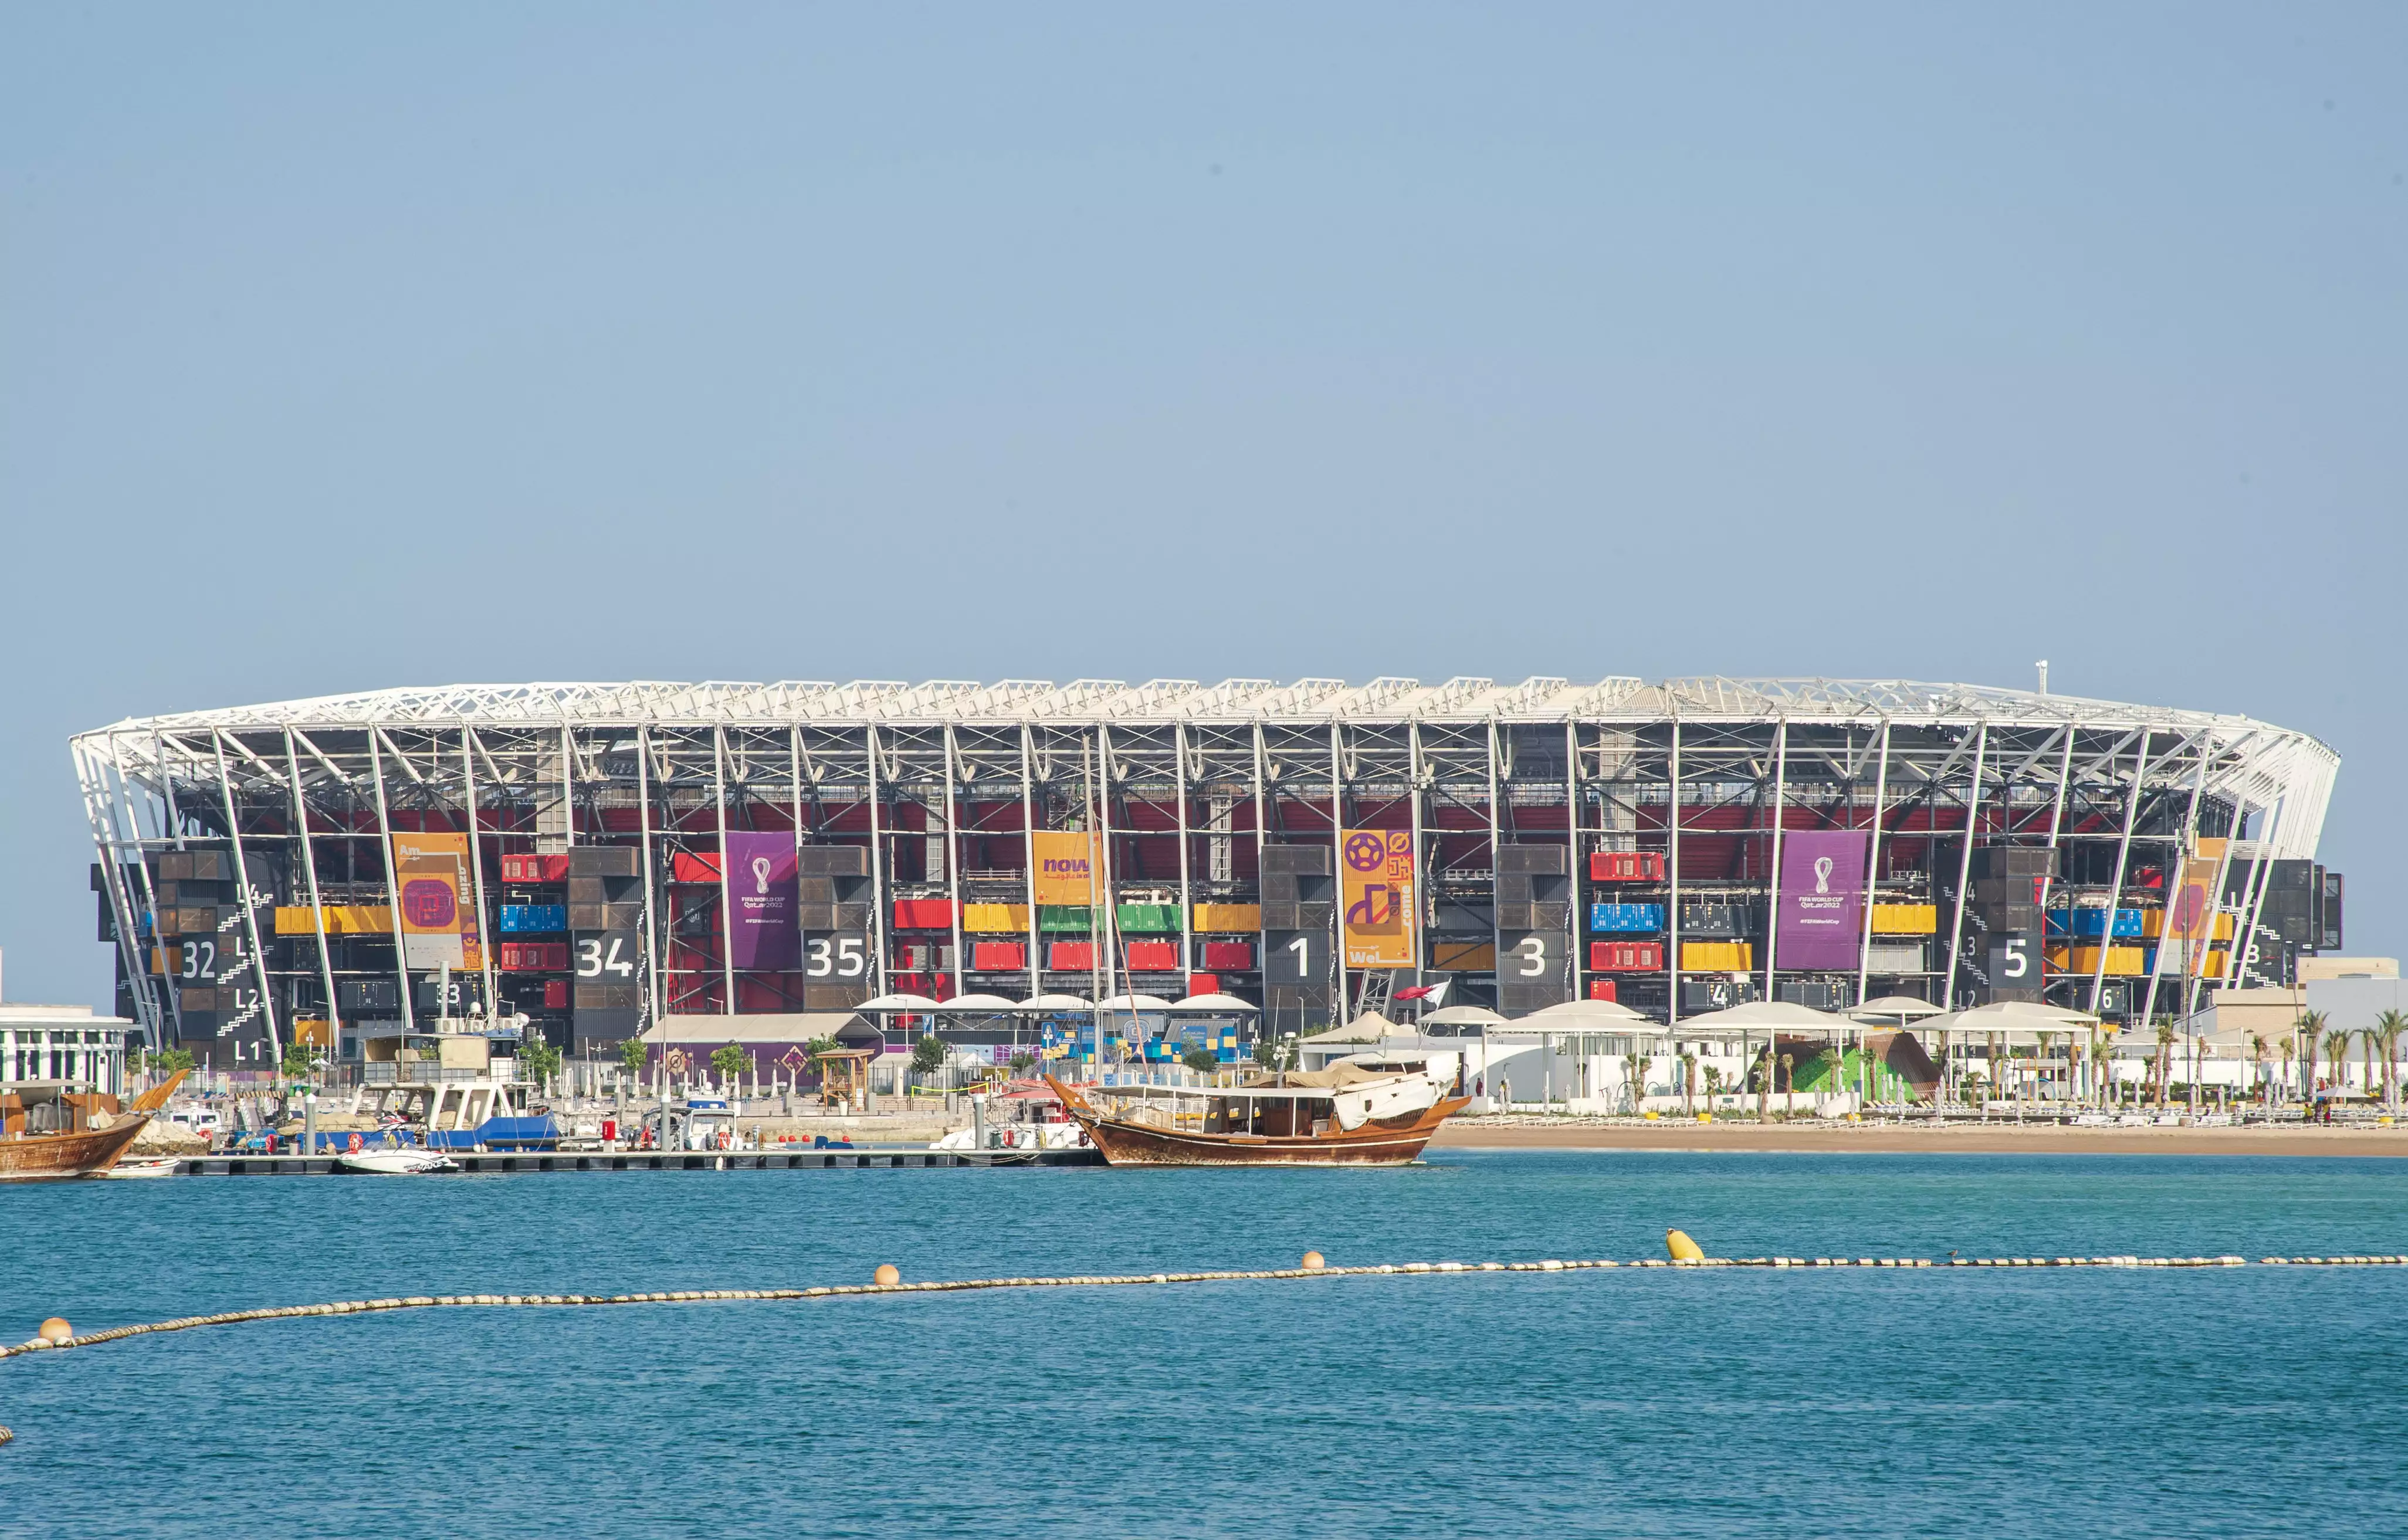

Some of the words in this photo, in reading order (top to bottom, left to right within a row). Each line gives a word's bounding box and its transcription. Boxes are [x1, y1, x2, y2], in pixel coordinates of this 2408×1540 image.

[1043, 859, 1089, 873] now
[183, 941, 215, 978] 32
[577, 938, 633, 976] 34
[807, 938, 863, 976] 35
[1289, 938, 1308, 976] 1
[1520, 938, 1545, 976] 3
[2004, 939, 2027, 977] 5
[236, 988, 259, 1008] L2
[1712, 985, 1728, 1005] 4
[2103, 989, 2112, 1009] 6
[235, 1040, 259, 1060] L1
